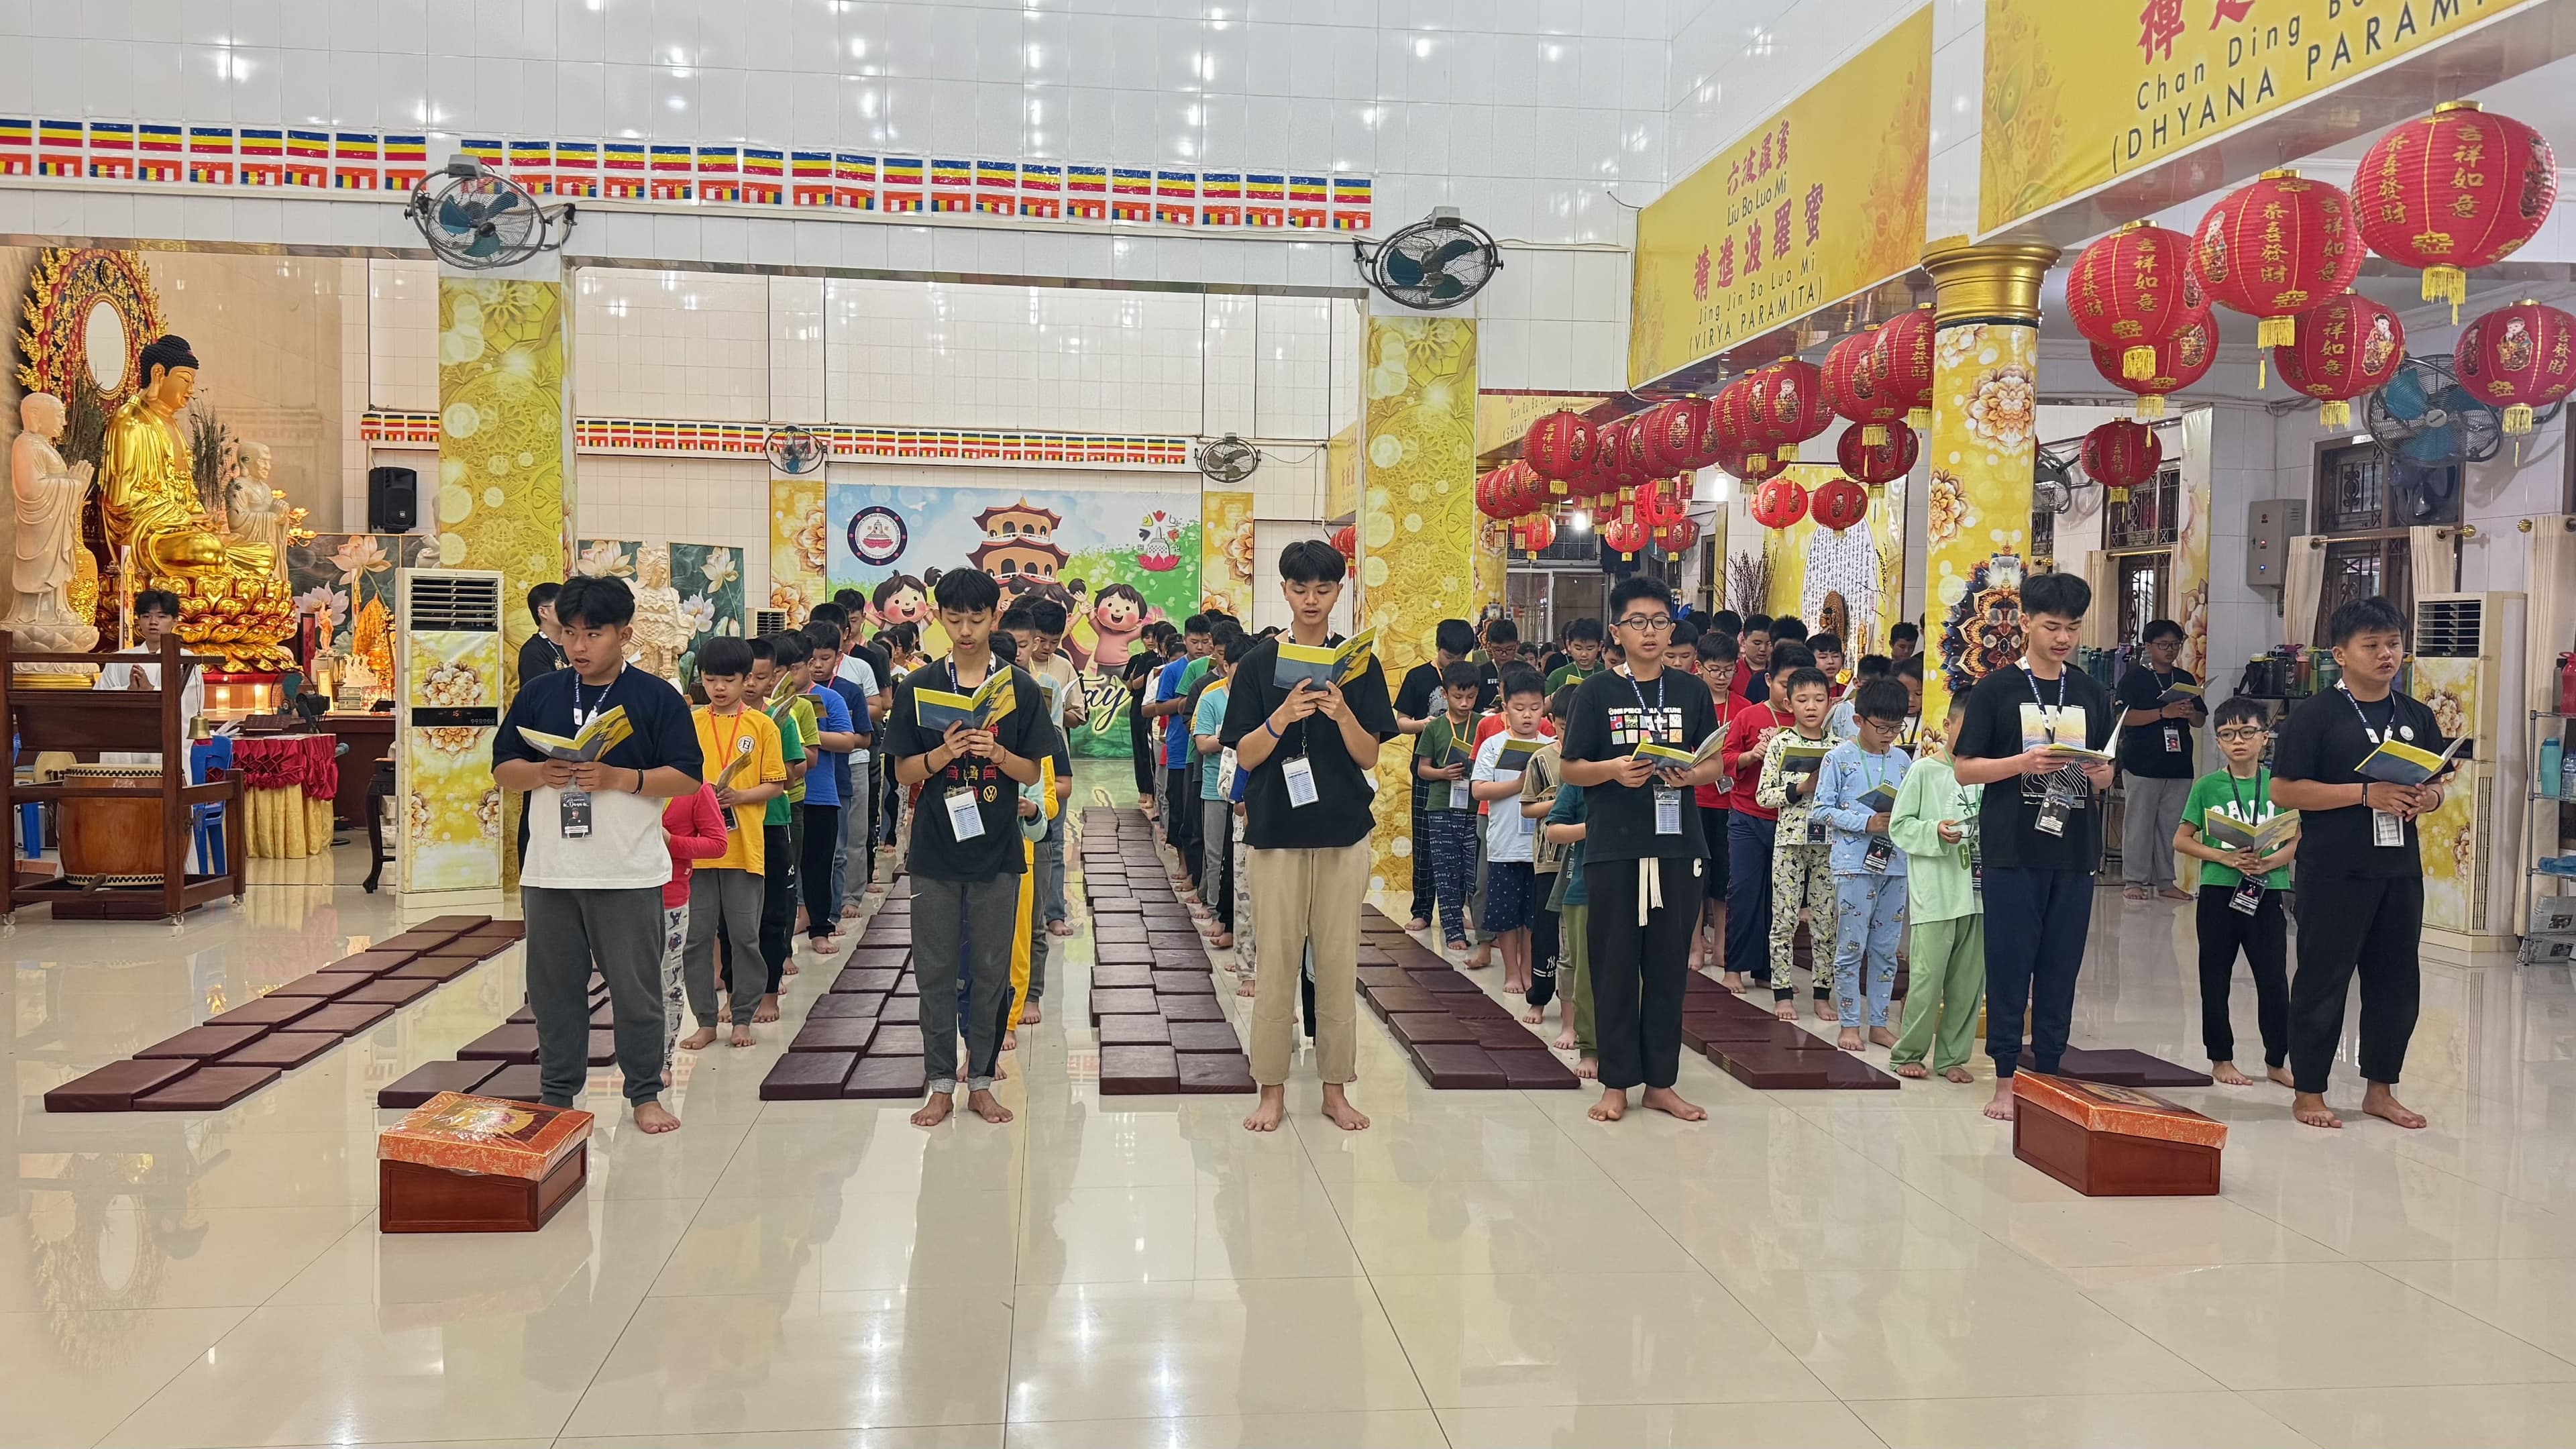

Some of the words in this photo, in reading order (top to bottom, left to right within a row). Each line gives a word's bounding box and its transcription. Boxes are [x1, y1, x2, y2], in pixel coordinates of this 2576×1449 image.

[2113, 65, 2275, 174] (DHYANA
[2307, 0, 2483, 81] PARAM
[2137, 62, 2204, 111] Chan
[2228, 15, 2300, 68] Ding
[2328, 0, 2365, 20] B
[1727, 119, 1790, 196] 六波羅蜜
[1727, 203, 1739, 227] Liu
[1742, 196, 1753, 218] Bo
[1756, 188, 1772, 210] Luo
[1774, 170, 1787, 199] Mi
[2377, 133, 2410, 225] 恭喜發財
[2445, 124, 2485, 219] 吉祥如意
[1693, 182, 1824, 302] 精進波羅蜜
[2133, 237, 2159, 312] 吉祥如意
[2258, 201, 2290, 284] 恭喜發財
[2315, 197, 2346, 281] 吉祥如意
[1688, 320, 1731, 360] (VIRYA
[1741, 276, 1823, 333] PARAMITA)
[1699, 305, 1720, 325] Jing
[1727, 292, 1742, 312] Jin
[1750, 282, 1763, 301] Bo
[1771, 270, 1792, 290] Luo
[1801, 252, 1815, 276] Mi
[2318, 305, 2349, 376] 吉祥如意
